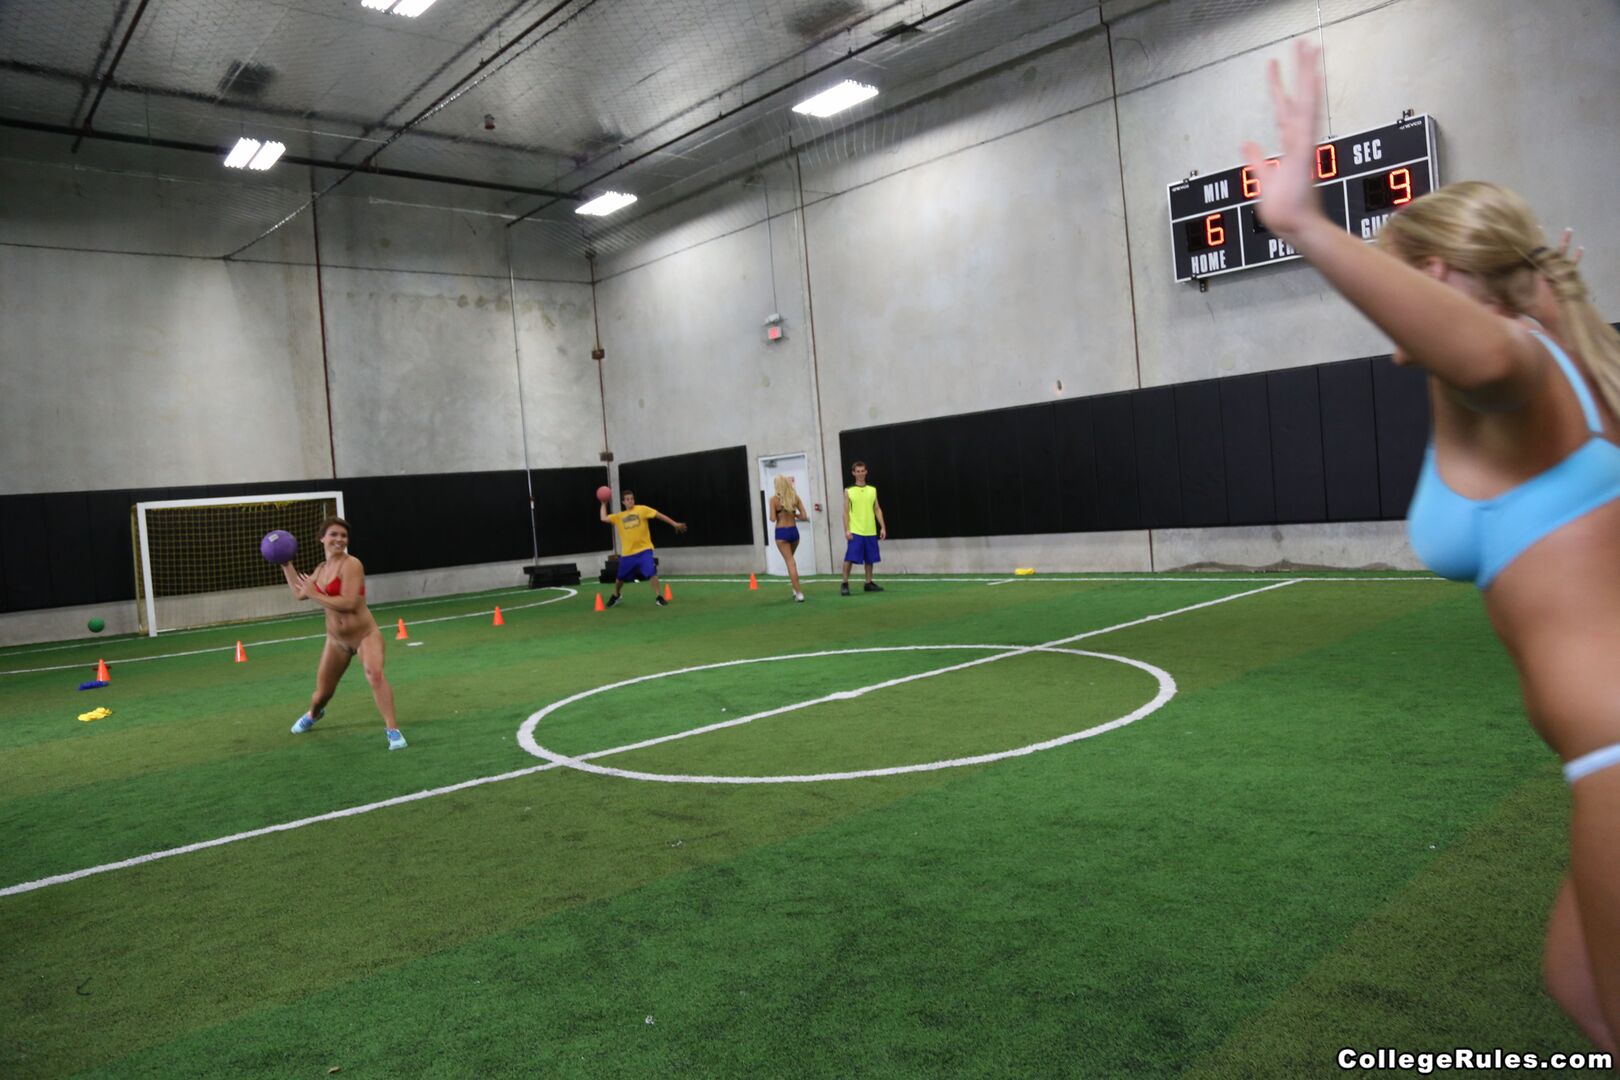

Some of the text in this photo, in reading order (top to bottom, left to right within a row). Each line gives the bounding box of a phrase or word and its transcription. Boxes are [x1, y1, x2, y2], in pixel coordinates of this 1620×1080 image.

[1203, 179, 1229, 204] MIN
[1353, 138, 1382, 165] SEC
[1388, 168, 1412, 205] 9
[1205, 213, 1225, 247] 6
[1191, 250, 1226, 275] HOME
